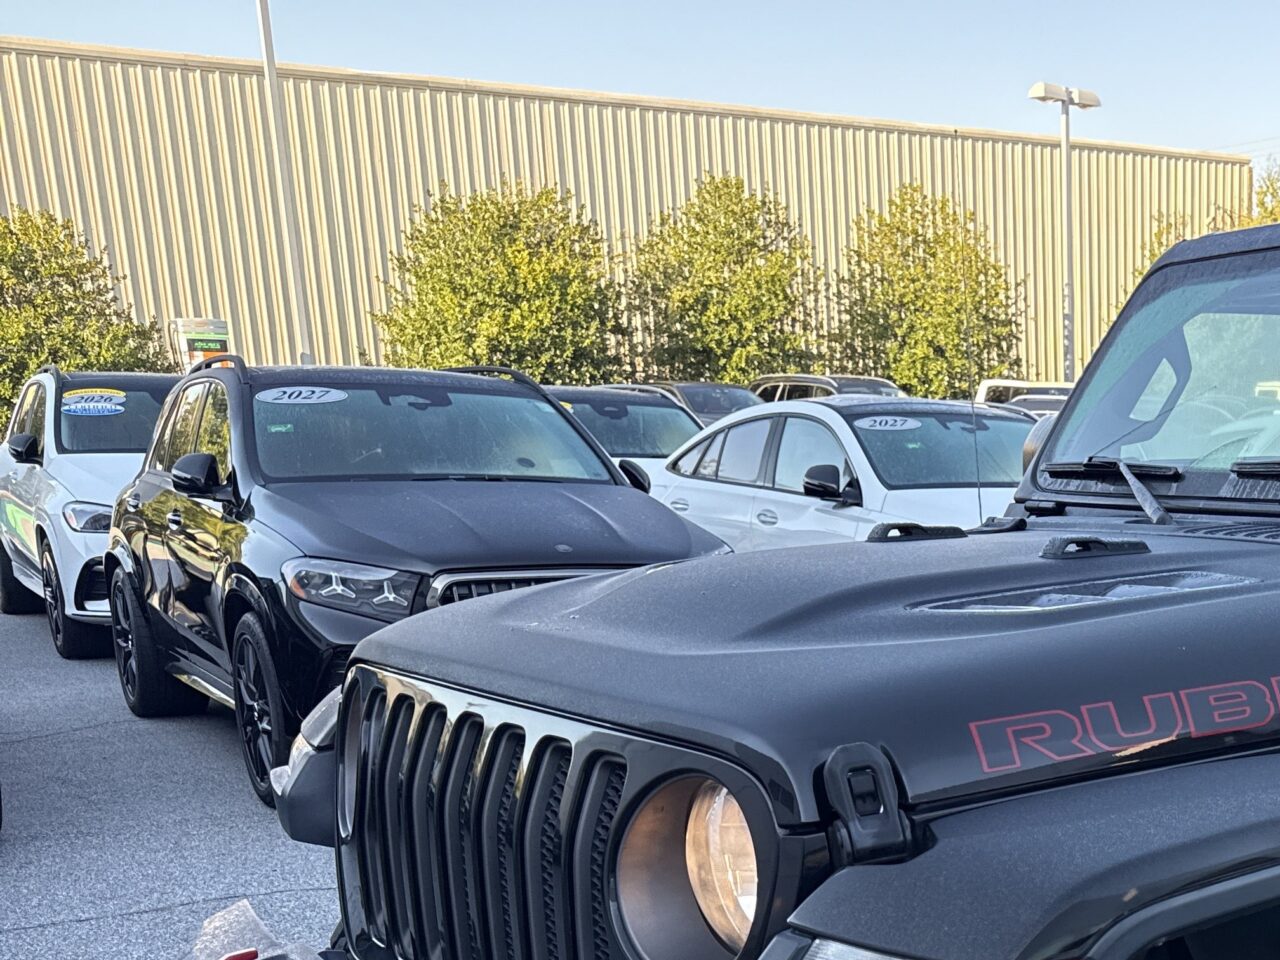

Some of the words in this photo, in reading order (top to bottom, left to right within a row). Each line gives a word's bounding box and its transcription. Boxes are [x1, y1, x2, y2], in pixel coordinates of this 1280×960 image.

[72, 394, 113, 405] 2026
[271, 389, 332, 401] 2027
[868, 418, 909, 428] 2027
